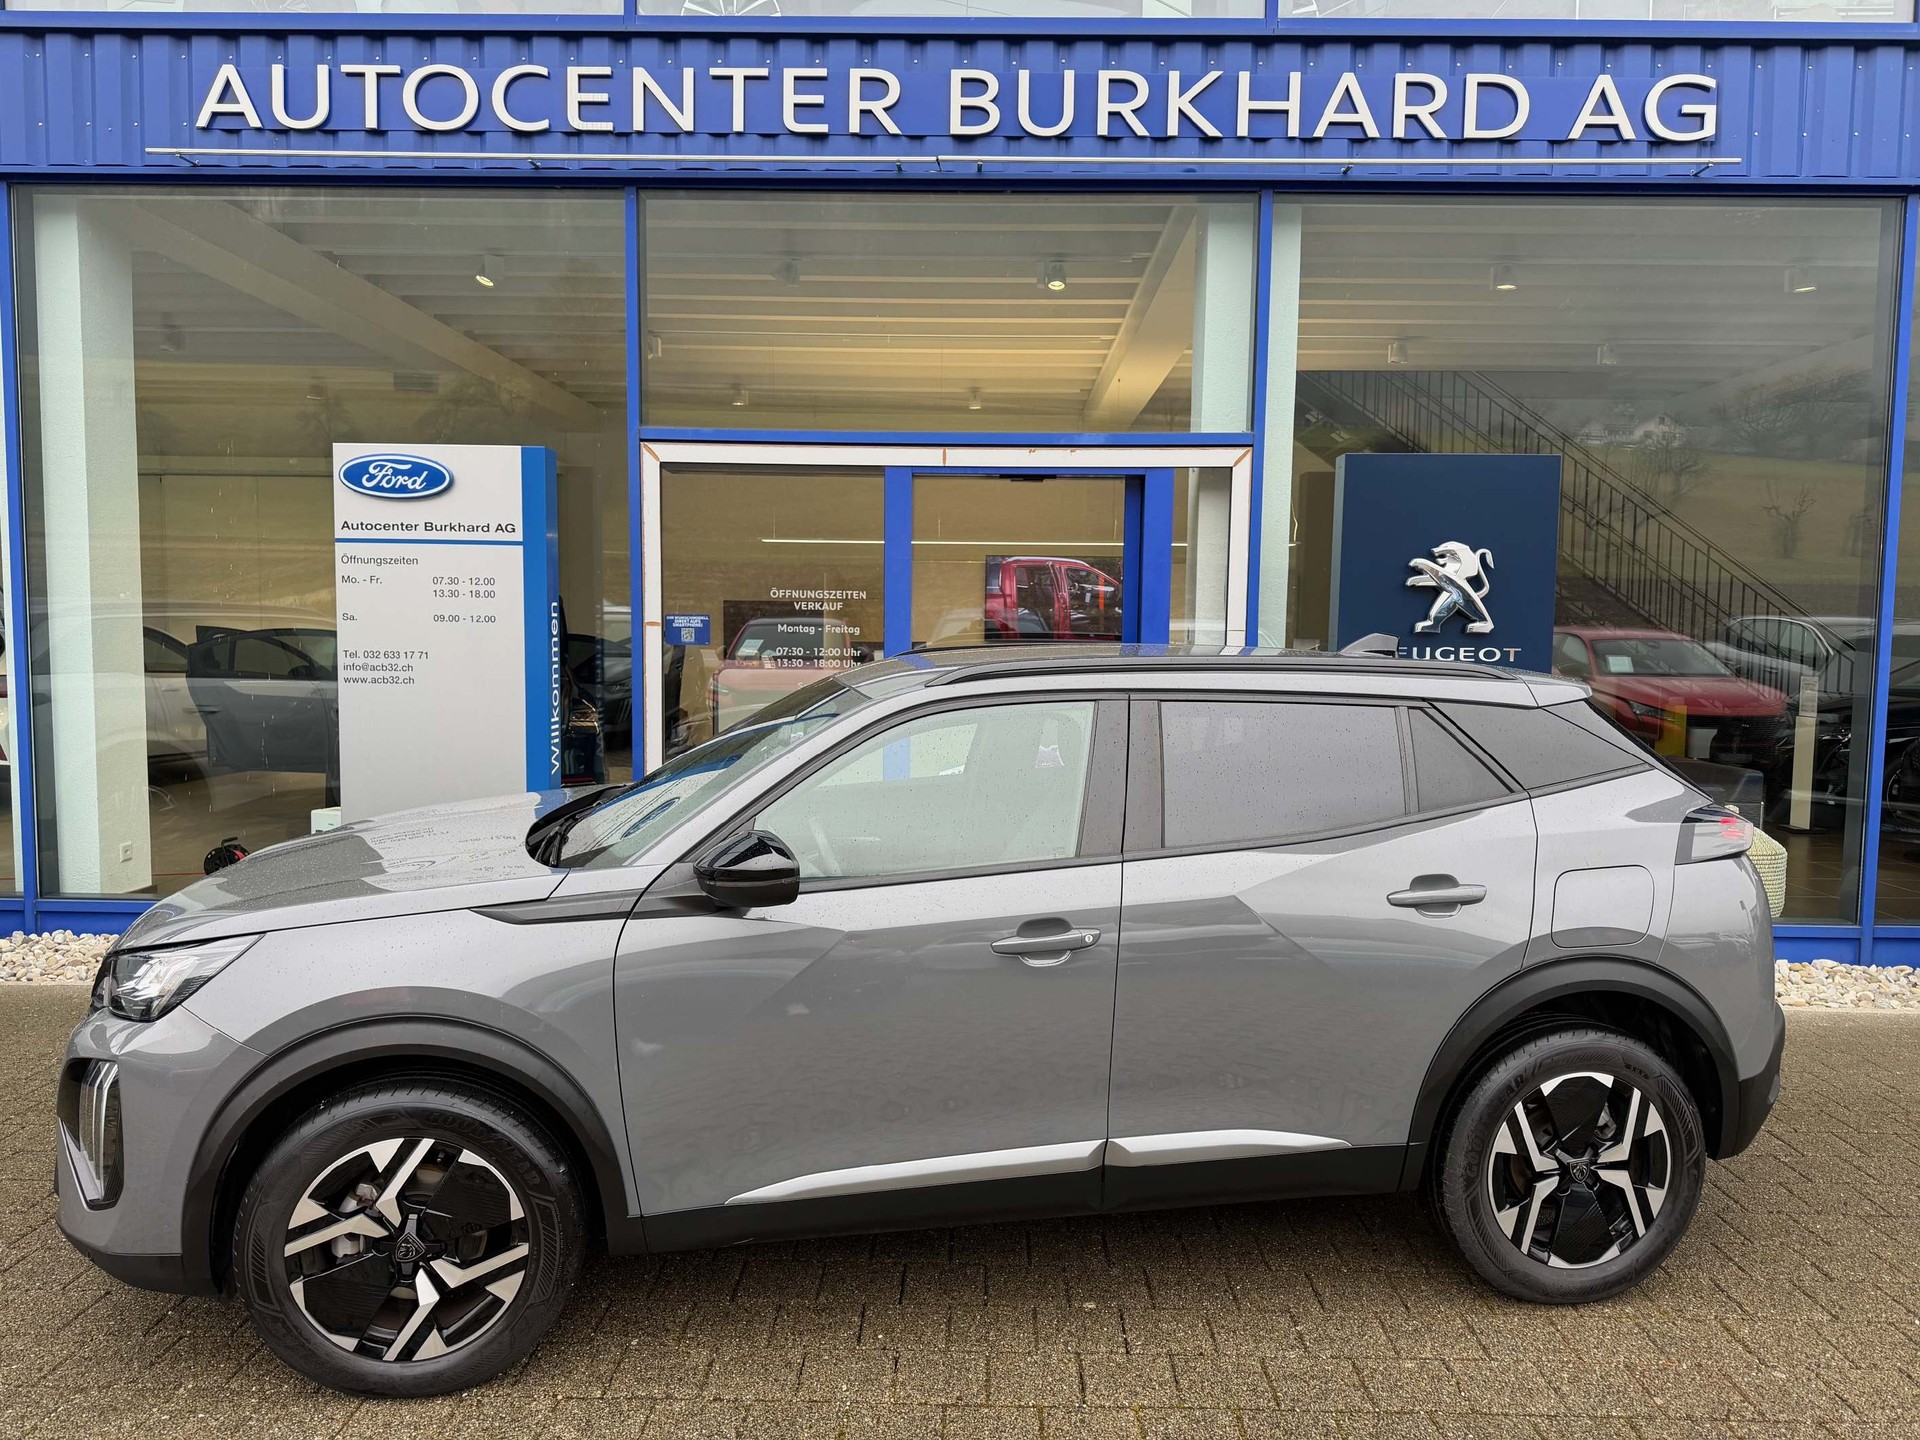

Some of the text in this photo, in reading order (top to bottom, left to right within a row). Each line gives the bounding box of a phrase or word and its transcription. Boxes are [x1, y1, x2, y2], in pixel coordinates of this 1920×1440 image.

[195, 63, 1718, 142] AUTOCENTER BURKHARD AG
[362, 460, 429, 490] Ford
[340, 520, 516, 534] Autocenter Burkhard AG
[340, 552, 419, 567] Öffnungszeiten
[341, 574, 360, 585] Mo.
[369, 575, 383, 586] Fr.
[432, 576, 460, 587] 07.30
[468, 577, 496, 587] 12.00
[432, 588, 460, 599] 13.30
[468, 589, 496, 599] 18.00
[770, 587, 867, 600] ÖFFNUNGSZEITEN
[793, 601, 844, 611] VERKAUF
[341, 612, 358, 622] Sa.
[433, 614, 461, 624] 09.00
[469, 614, 497, 624] 12.00
[777, 623, 816, 636] Montag
[824, 624, 861, 636] Freitag
[343, 649, 429, 661] Tel. 032 633 17 71
[775, 647, 804, 657] 07:30
[813, 648, 841, 657] 12:00
[843, 648, 862, 657] Uhr
[1399, 646, 1522, 663] UGEOT
[343, 662, 414, 674] info@acb32.ch
[777, 658, 804, 668] 13:30
[813, 659, 841, 669] 18:00
[843, 659, 862, 669] Uhr
[343, 675, 415, 686] www.acb32.ch
[550, 601, 560, 775] Willkommen
